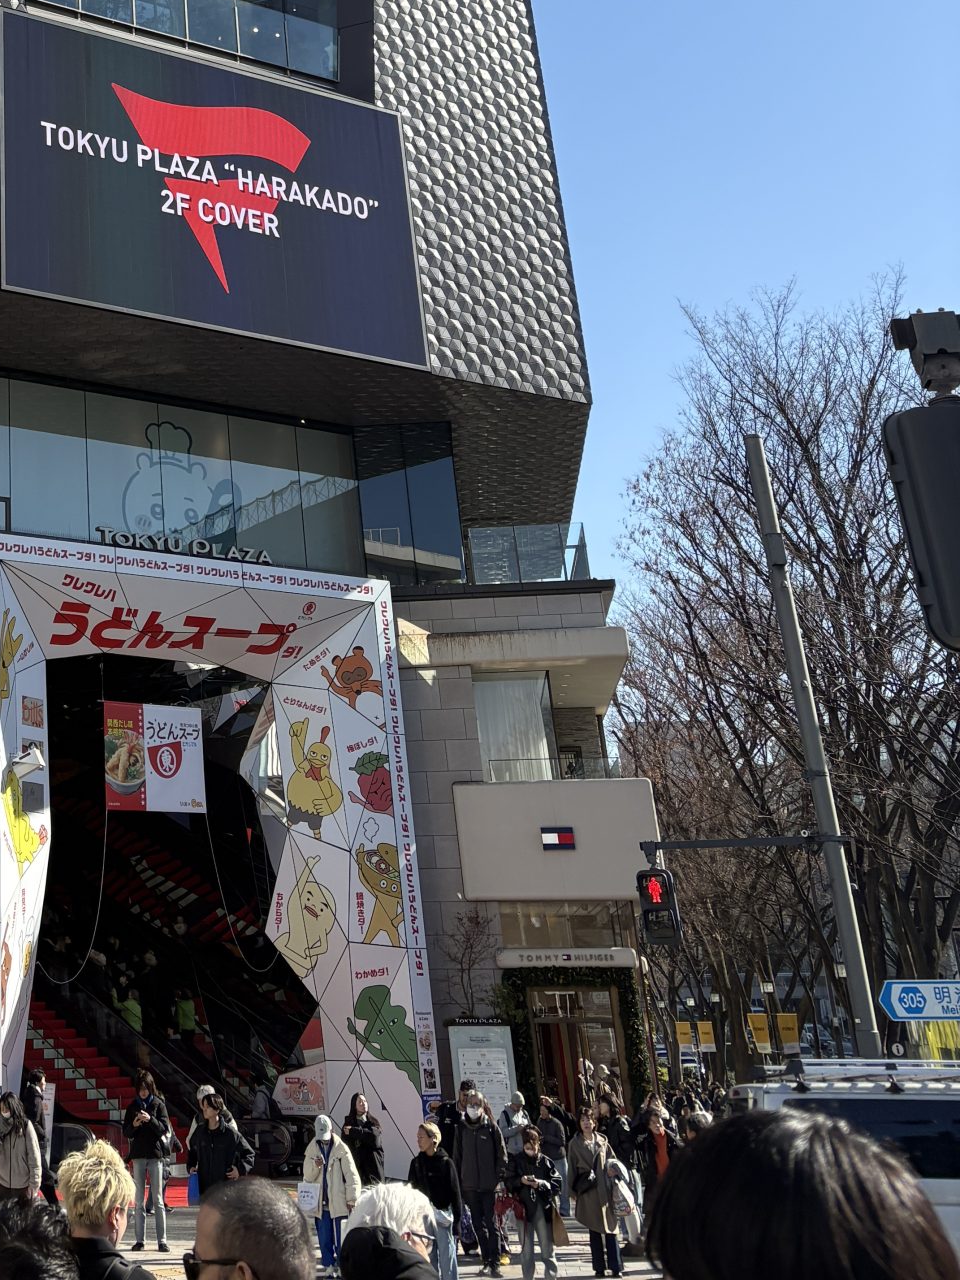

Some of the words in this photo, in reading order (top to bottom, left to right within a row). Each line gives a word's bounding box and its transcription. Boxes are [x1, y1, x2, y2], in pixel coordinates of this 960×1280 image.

[40, 121, 128, 163] TOKYU
[136, 143, 220, 185] PLAZA
[160, 189, 191, 216] 2F
[197, 197, 280, 238] COVER
[95, 526, 182, 553] TOKYU
[192, 538, 273, 565] PLAZA
[49, 600, 298, 655] うどんスープ
[146, 720, 200, 740] うどんスープ
[518, 954, 559, 962] TOMMY
[574, 953, 614, 962] HILFIGER
[900, 992, 925, 1008] 305
[941, 1005, 960, 1015] Mei
